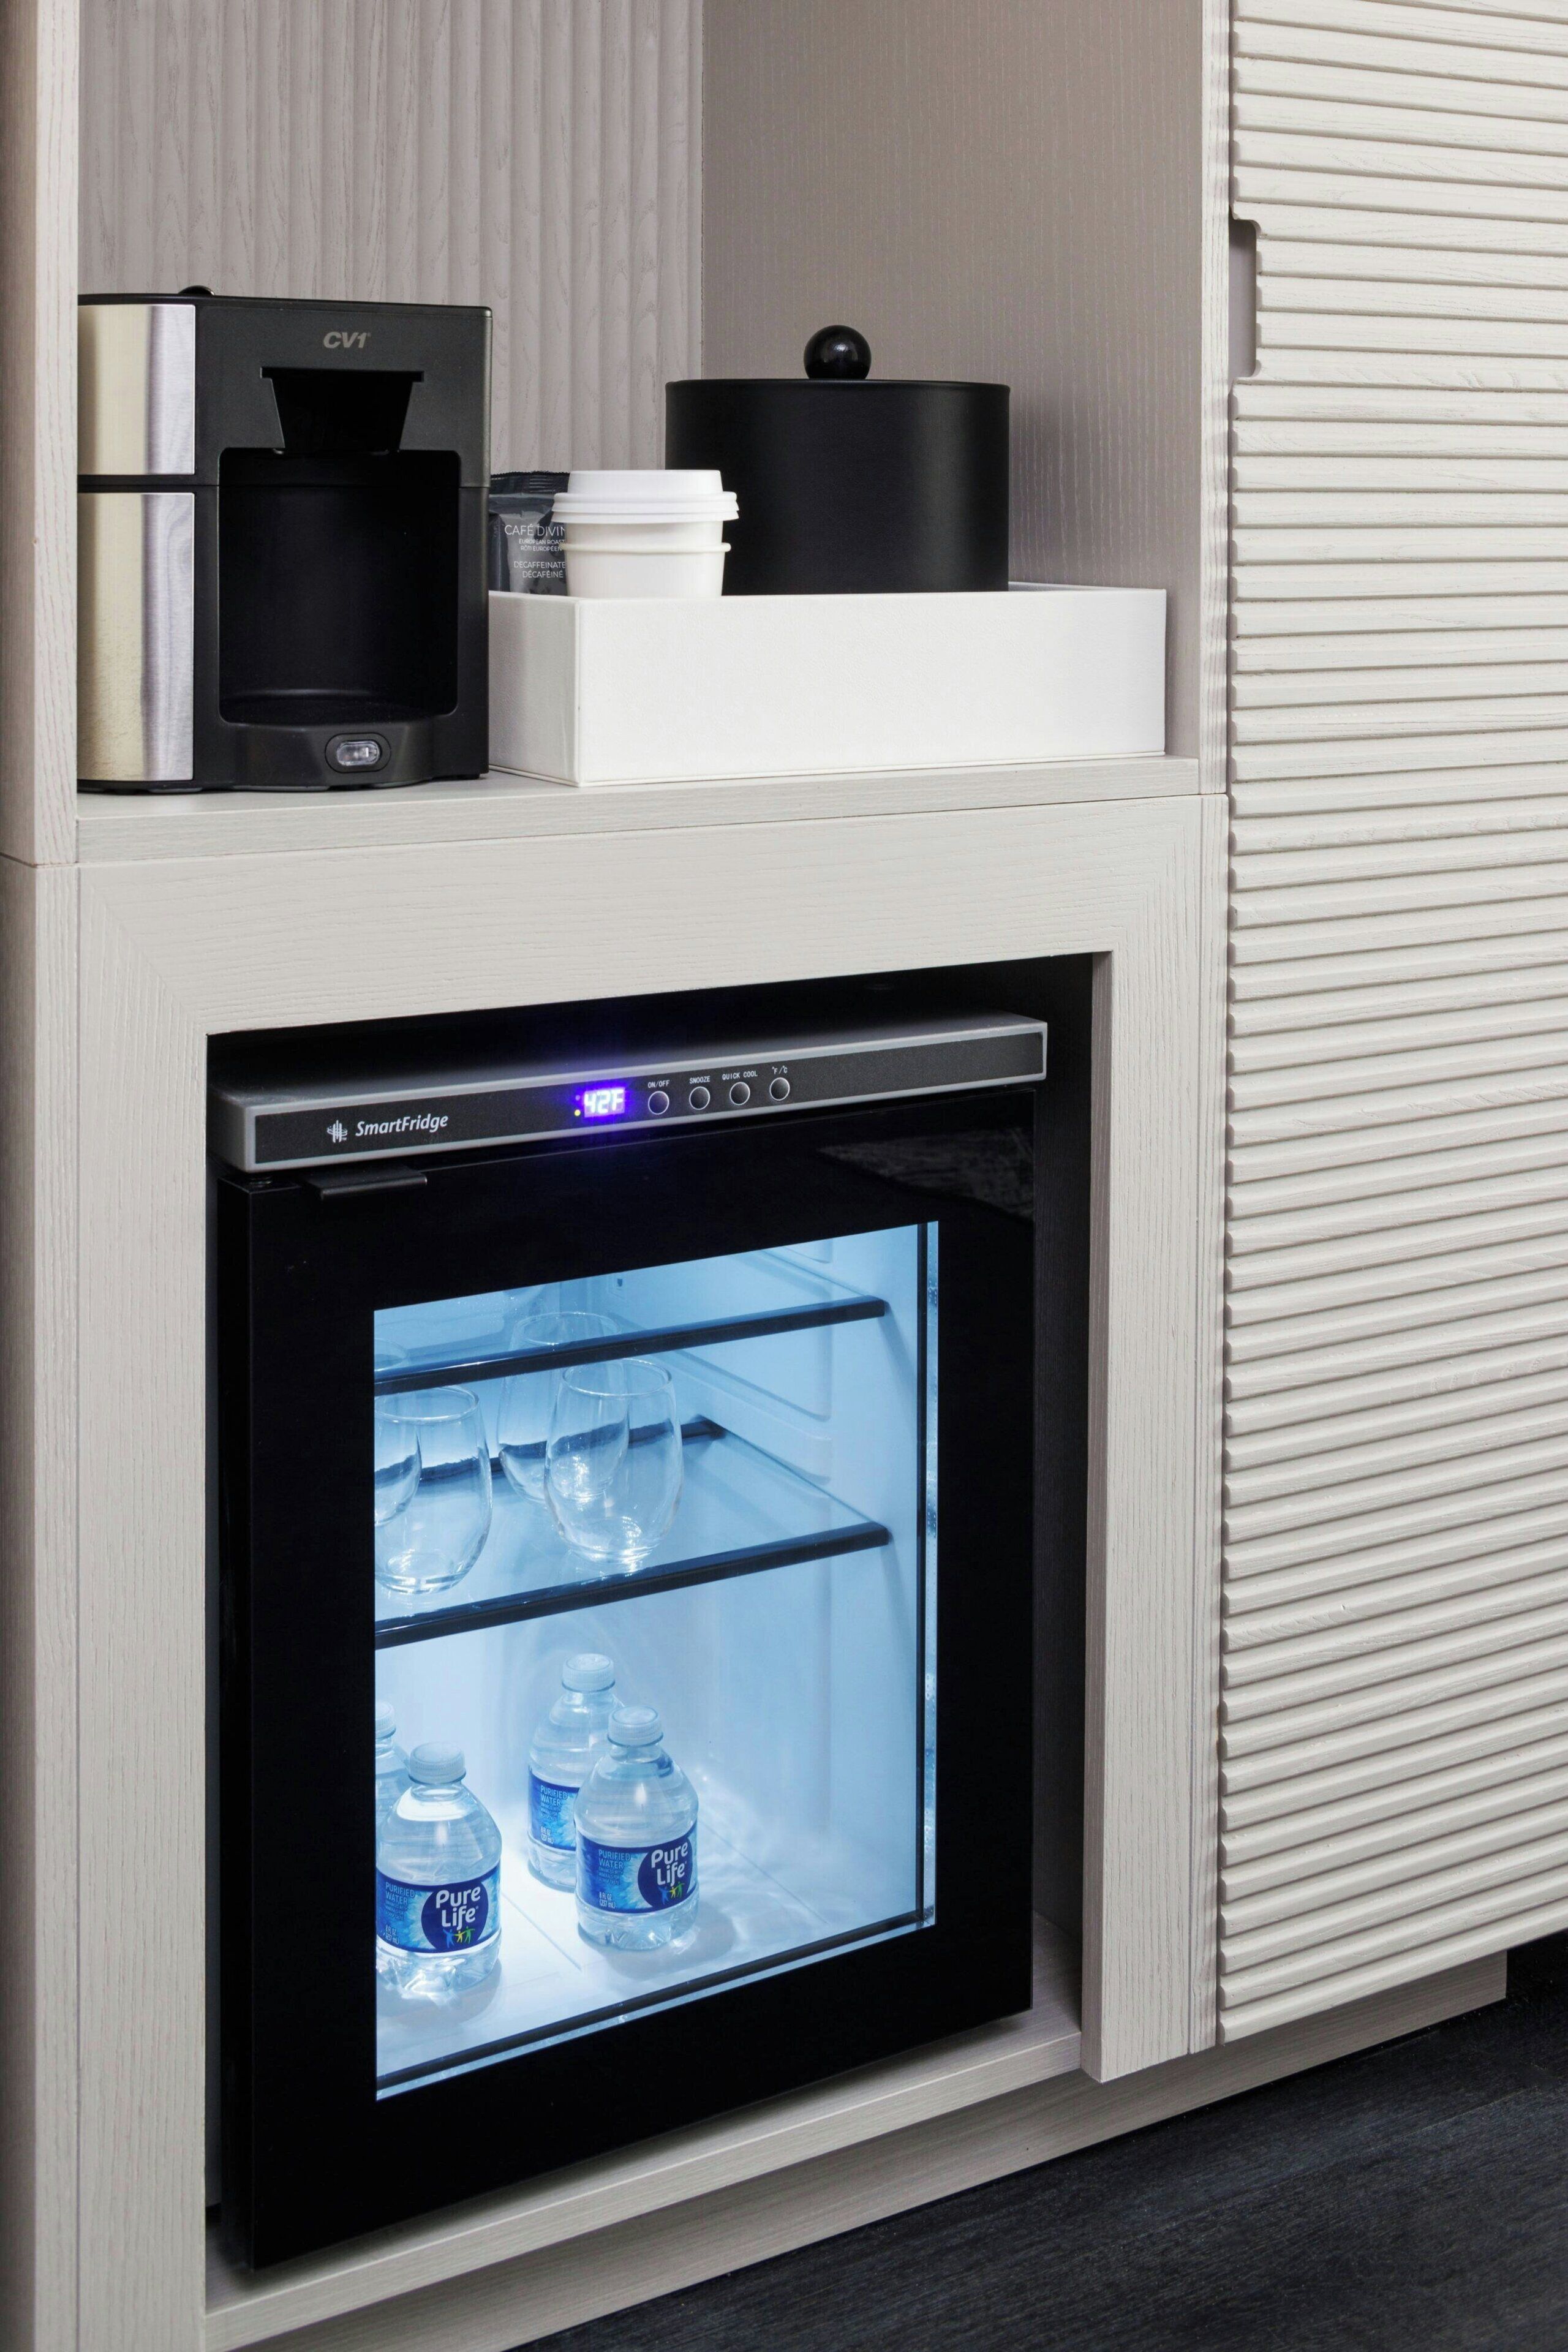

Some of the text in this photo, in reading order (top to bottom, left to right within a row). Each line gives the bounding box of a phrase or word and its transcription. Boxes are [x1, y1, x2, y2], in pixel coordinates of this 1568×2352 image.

[323, 331, 368, 349] CV1
[505, 524, 534, 536] CAFÉ
[647, 1080, 669, 1088] ON/OFF
[690, 1076, 710, 1084] SNOOZE
[355, 1114, 448, 1136] SmartFridge
[541, 1785, 568, 1800] PURIFIED
[541, 1794, 561, 1806] WATER
[598, 1849, 630, 1861] PURIFIED
[651, 1842, 688, 1868] Pure
[599, 1858, 624, 1869] WATER
[657, 1861, 685, 1887] Life
[386, 1882, 415, 1898] PURIFIED
[386, 1891, 408, 1904] WATER
[436, 1887, 481, 1909] Pure
[442, 1905, 475, 1931] Life
